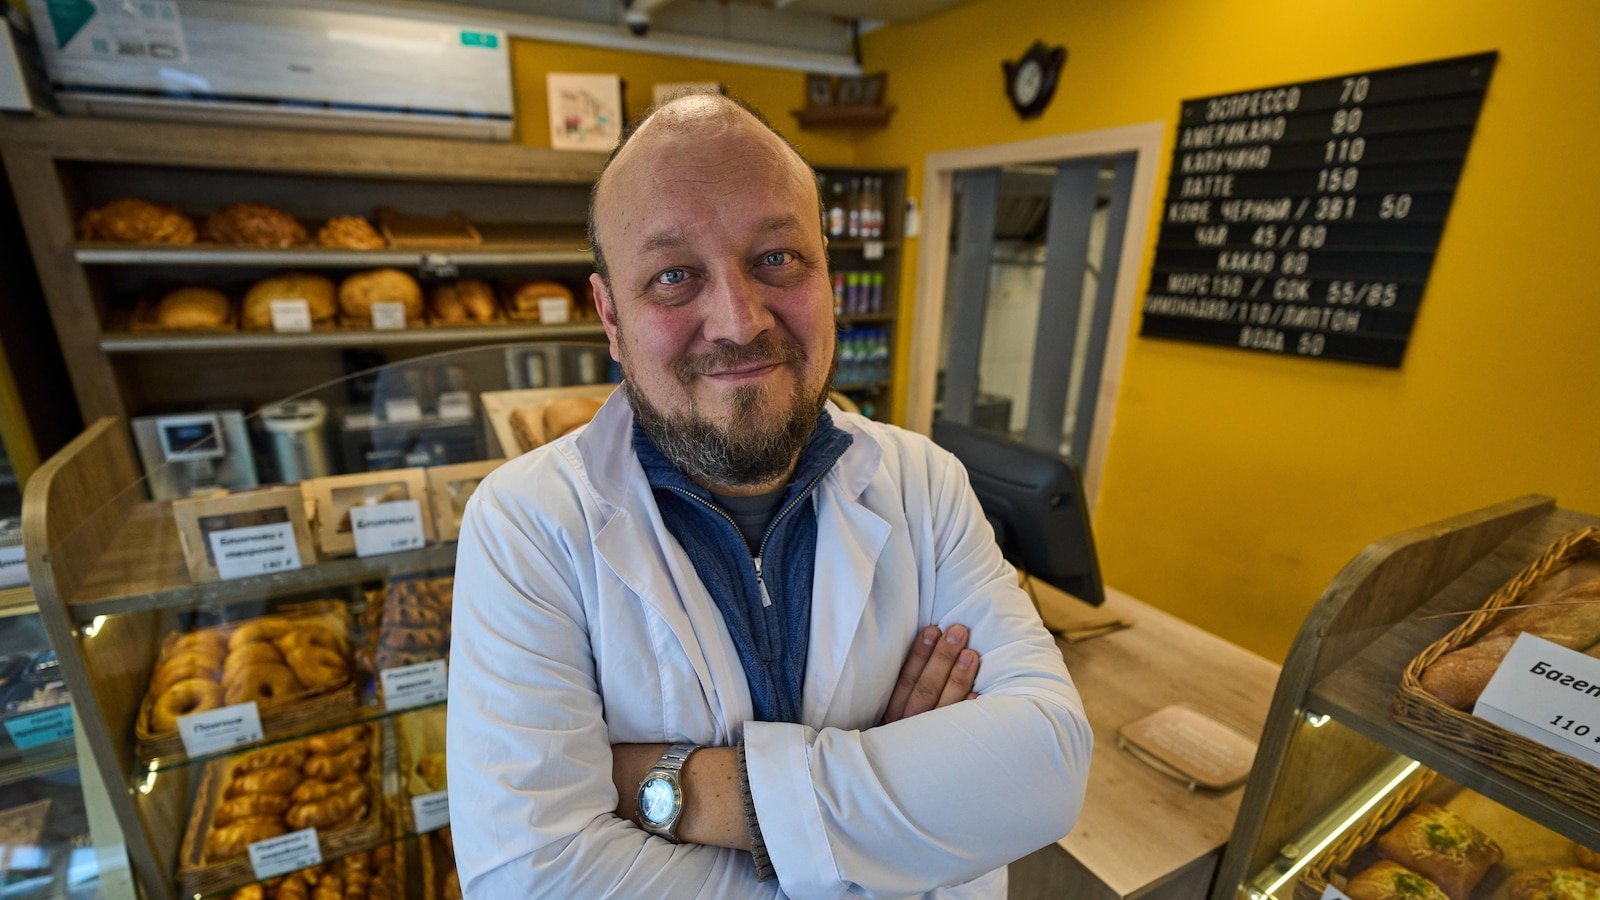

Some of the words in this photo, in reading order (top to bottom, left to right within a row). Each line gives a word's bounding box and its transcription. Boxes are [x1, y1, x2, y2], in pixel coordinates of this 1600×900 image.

[1341, 77, 1370, 103] 70
[1182, 116, 1287, 147] АМЕРИКАНО
[1327, 138, 1365, 162] 110
[1182, 175, 1234, 197] ЛАТТЕ
[1319, 168, 1358, 191] 150
[1169, 201, 1211, 222] КОФЕ
[1380, 194, 1412, 219] 50
[1219, 251, 1275, 273] КАКАО
[1275, 279, 1311, 301] СОК
[1549, 714, 1590, 736] 110
